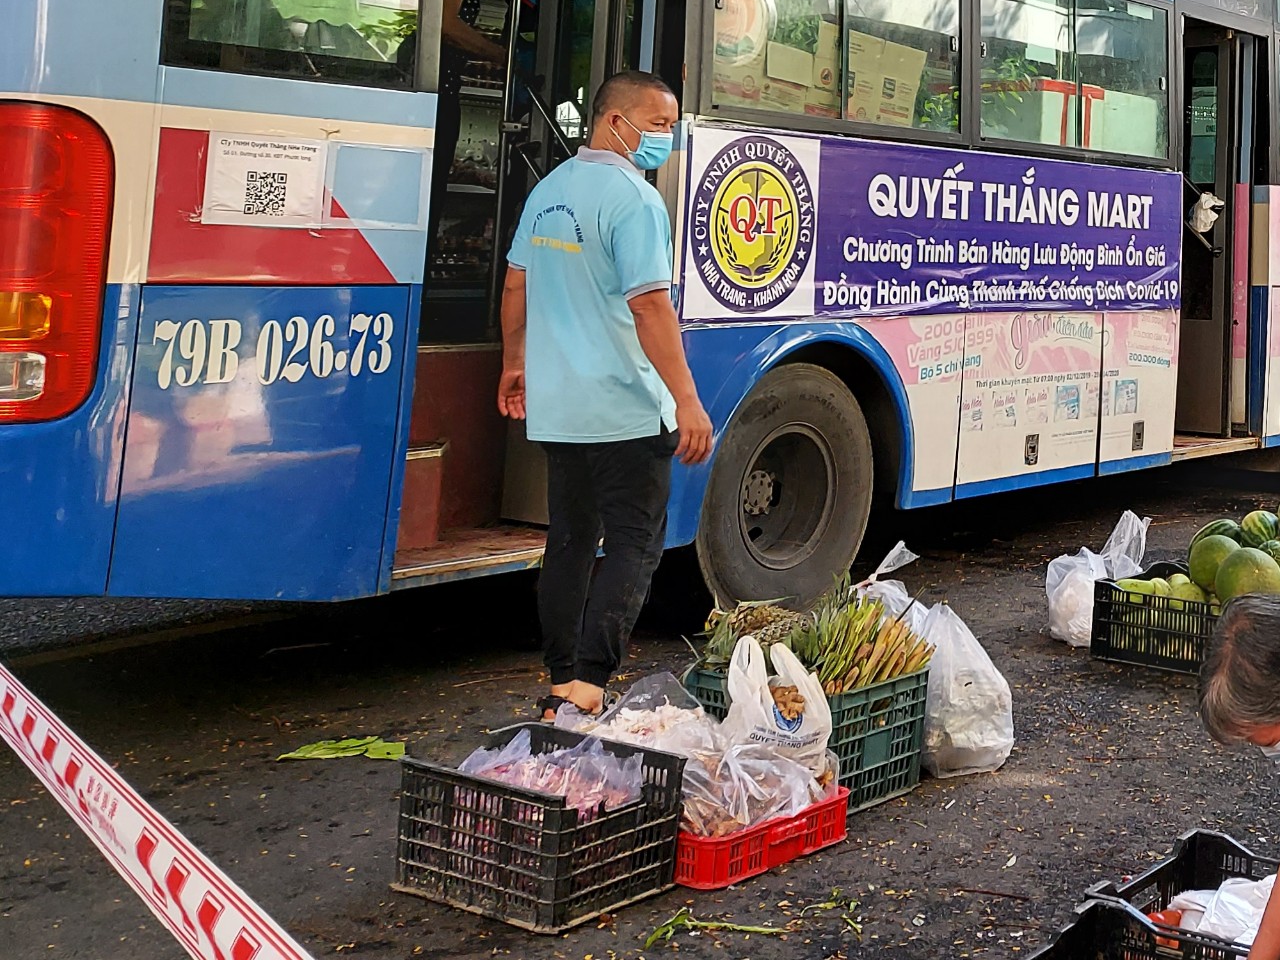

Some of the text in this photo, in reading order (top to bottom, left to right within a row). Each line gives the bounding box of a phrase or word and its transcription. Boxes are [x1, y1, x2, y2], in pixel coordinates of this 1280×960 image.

[695, 142, 815, 243] CTY TNHH QUYẾT THẮNG
[868, 162, 1153, 230] QUYẾT THẮNG MART
[729, 195, 782, 243] QT
[843, 234, 1166, 271] Chương Trình Bán Hàng Lưu Động Bình Ổn Giá
[701, 258, 716, 289] NHA
[716, 283, 747, 307] TRANG
[753, 281, 786, 307] KHÁNH
[784, 262, 801, 287] HÒA
[823, 272, 872, 312] Đồng
[877, 278, 921, 305] Hành
[925, 277, 969, 308] Cùng
[972, 278, 1016, 302] Thành
[1018, 275, 1049, 301] Phố
[1050, 275, 1094, 307] Chống
[1126, 280, 1179, 301] Covid-19
[153, 313, 394, 390] 79B 026.73
[924, 321, 952, 341] 200
[936, 363, 943, 376] 5
